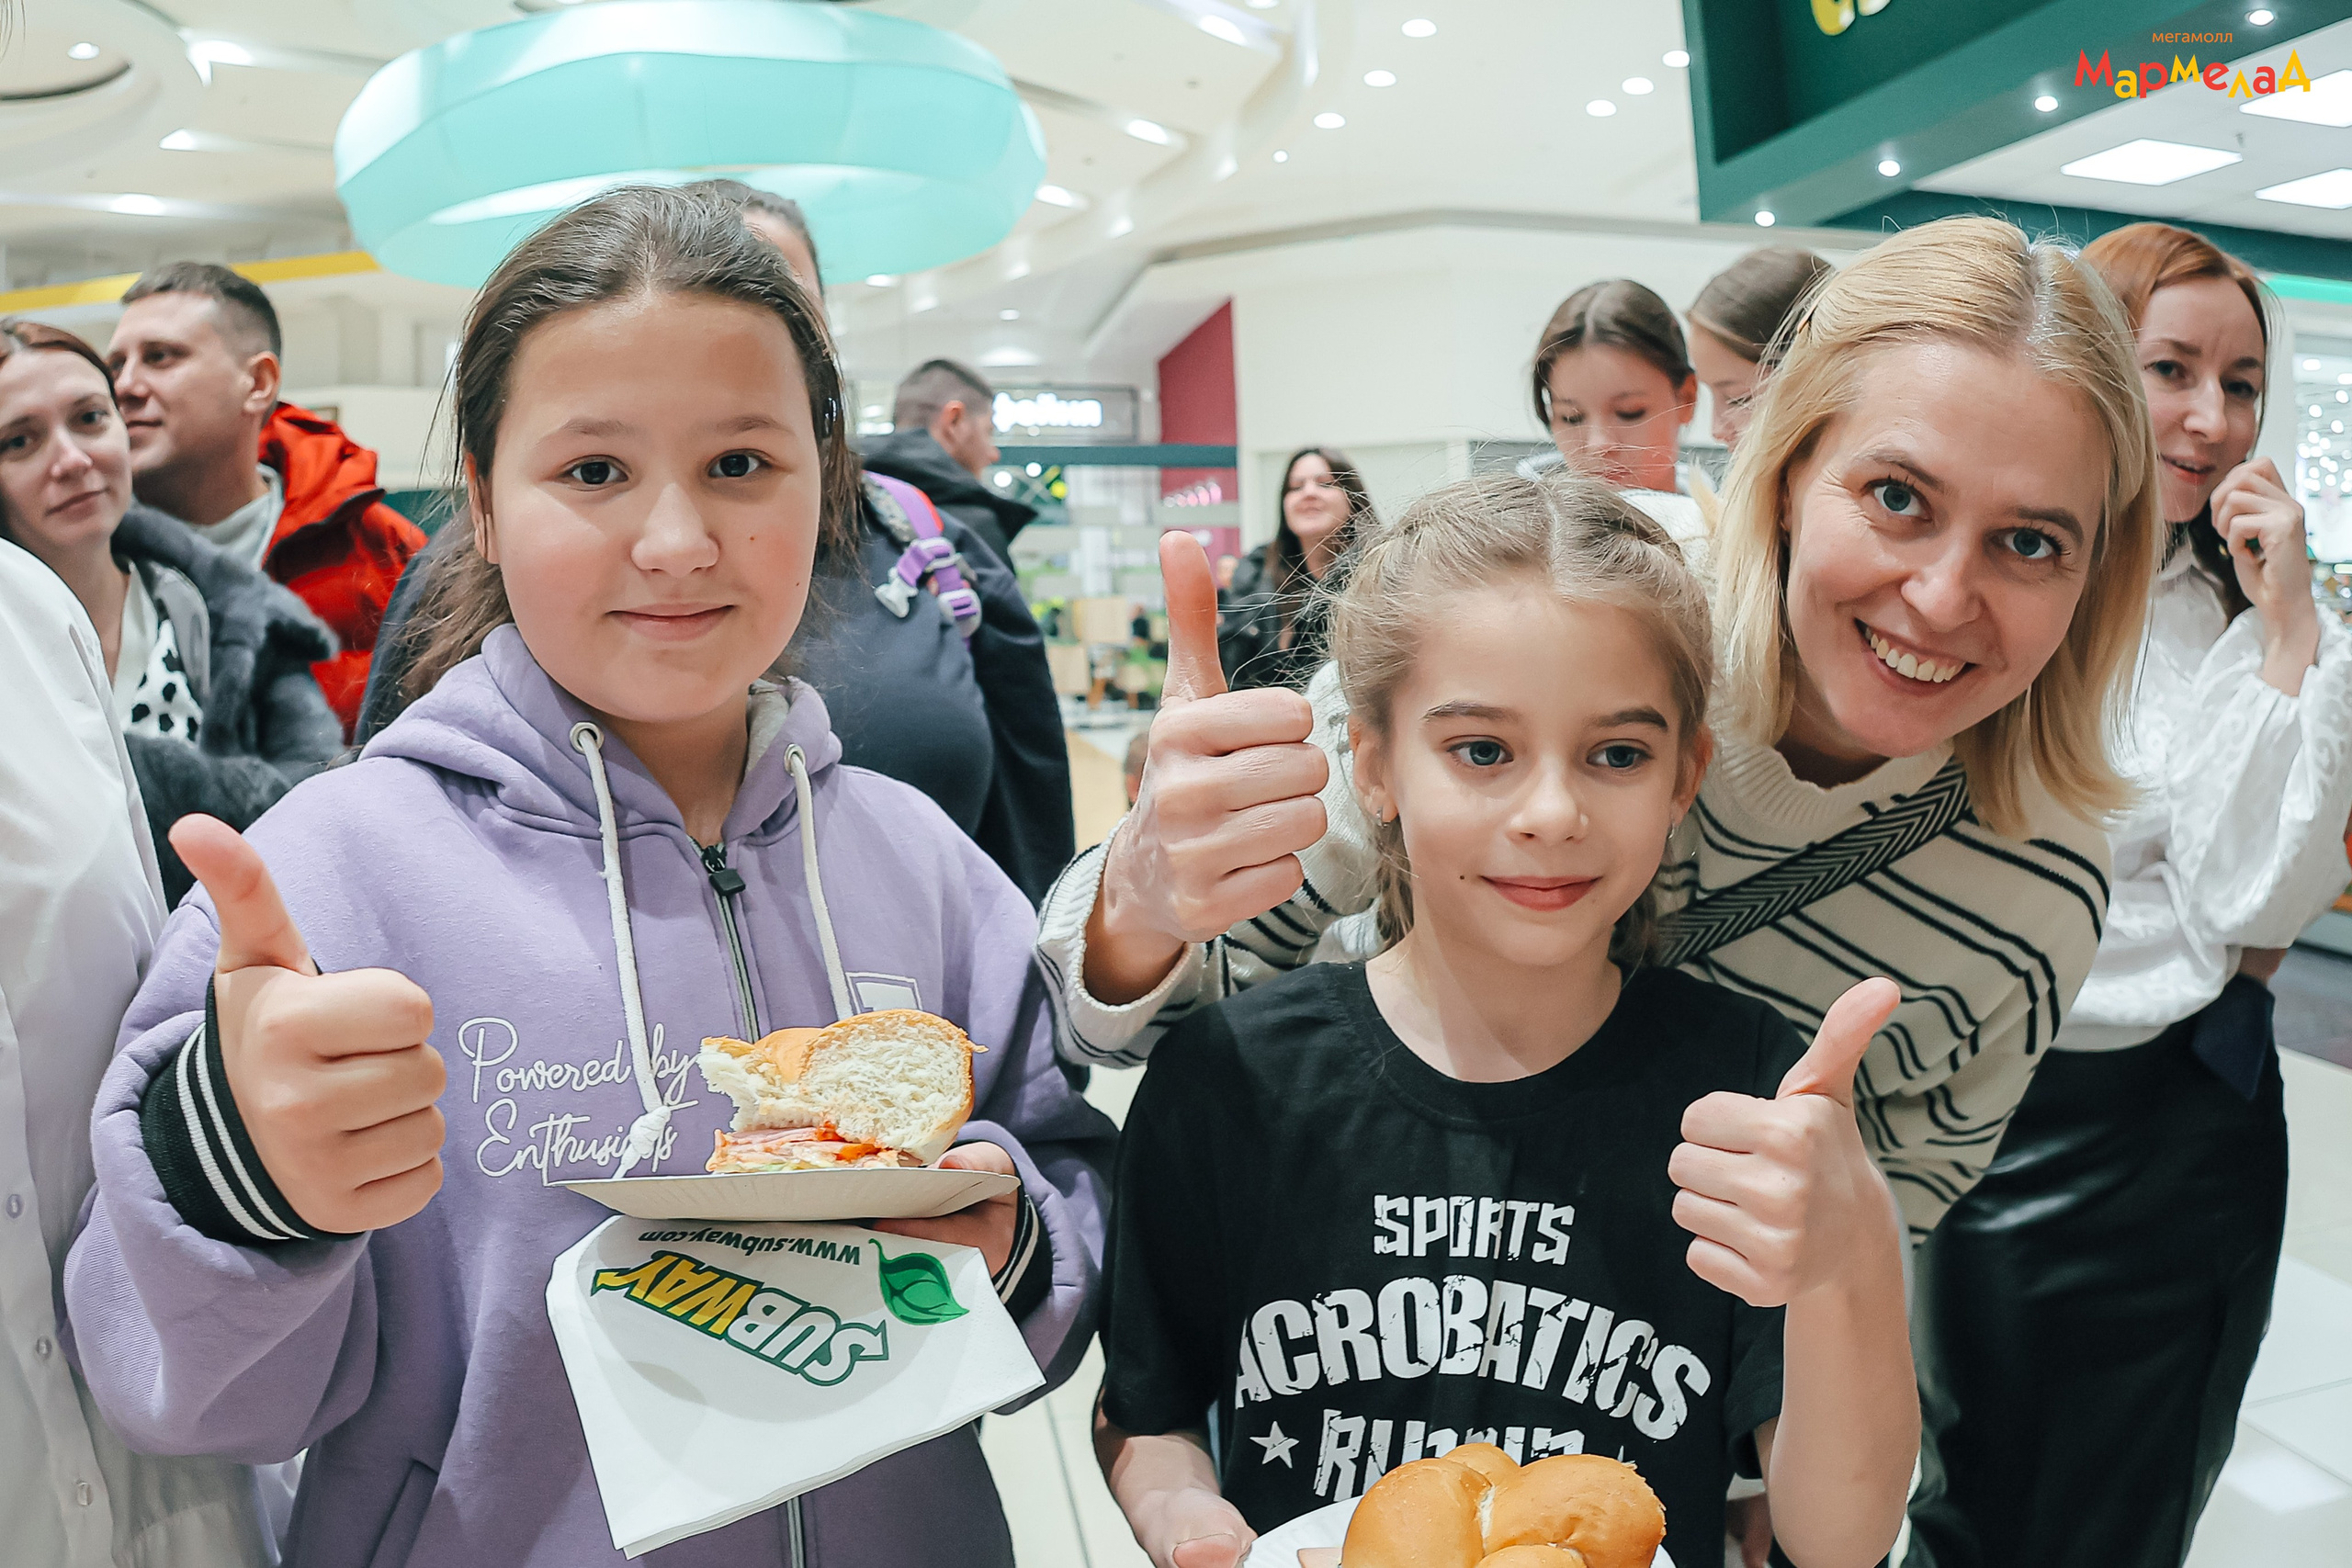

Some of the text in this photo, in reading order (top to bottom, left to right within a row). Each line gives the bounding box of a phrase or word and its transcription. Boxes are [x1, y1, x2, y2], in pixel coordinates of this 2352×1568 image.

[458, 1017, 700, 1111] Powered by
[639, 1230, 861, 1265] www.subway.com
[1374, 1195, 1575, 1265] SPORTS
[590, 1250, 888, 1386] SUBWAY
[1235, 1274, 1711, 1440] ACROBATICS
